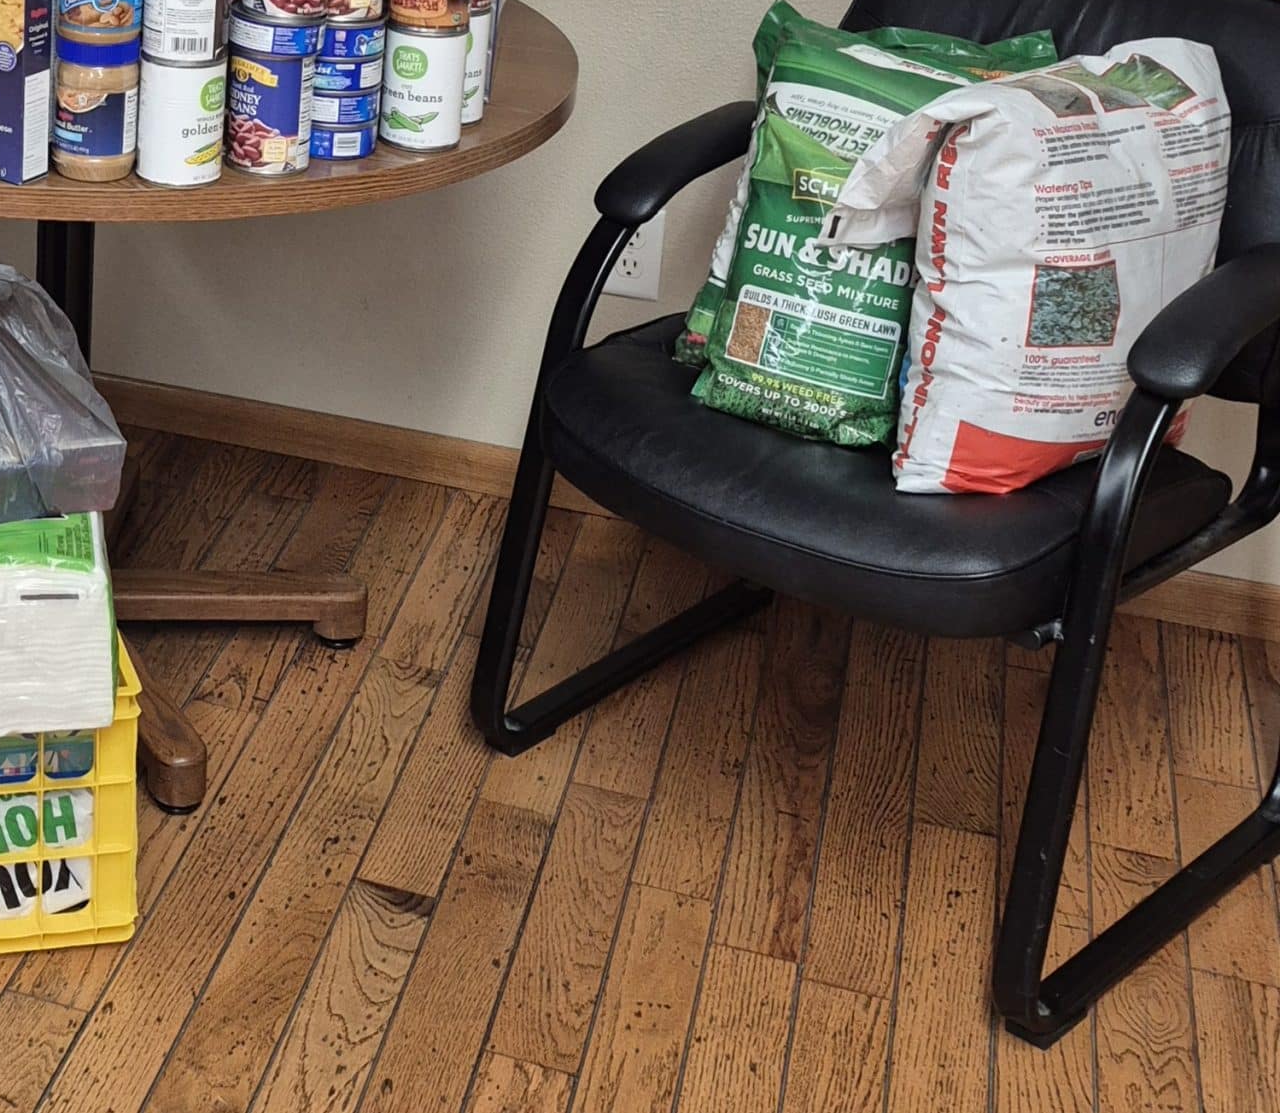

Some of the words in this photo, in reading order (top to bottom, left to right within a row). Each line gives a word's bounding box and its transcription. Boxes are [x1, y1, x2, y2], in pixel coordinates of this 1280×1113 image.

[407, 91, 443, 104] beans
[231, 102, 258, 116] EANS
[182, 125, 219, 138] golden
[785, 106, 861, 138] PROBLEMS
[1034, 183, 1079, 195] Watering
[1079, 179, 1093, 190] Tips
[785, 213, 826, 225] SUPREM
[744, 223, 795, 258] SUN
[798, 231, 824, 267] &
[926, 200, 948, 294] LAWN
[1044, 254, 1092, 265] COVERAGE
[752, 263, 794, 288] GRASS
[796, 275, 833, 294] SEED
[836, 284, 899, 311] MIXTURE
[743, 289, 771, 308] BUILDS
[771, 296, 779, 309] A
[838, 312, 870, 331] GREEN
[871, 319, 898, 337] LAWN
[1024, 354, 1048, 365] 100%
[1051, 354, 1101, 366] guaranteed
[718, 373, 762, 396] COVERS
[763, 387, 779, 403] UP
[780, 392, 799, 407] TO
[783, 379, 818, 399] WEED
[819, 389, 846, 407] FREE
